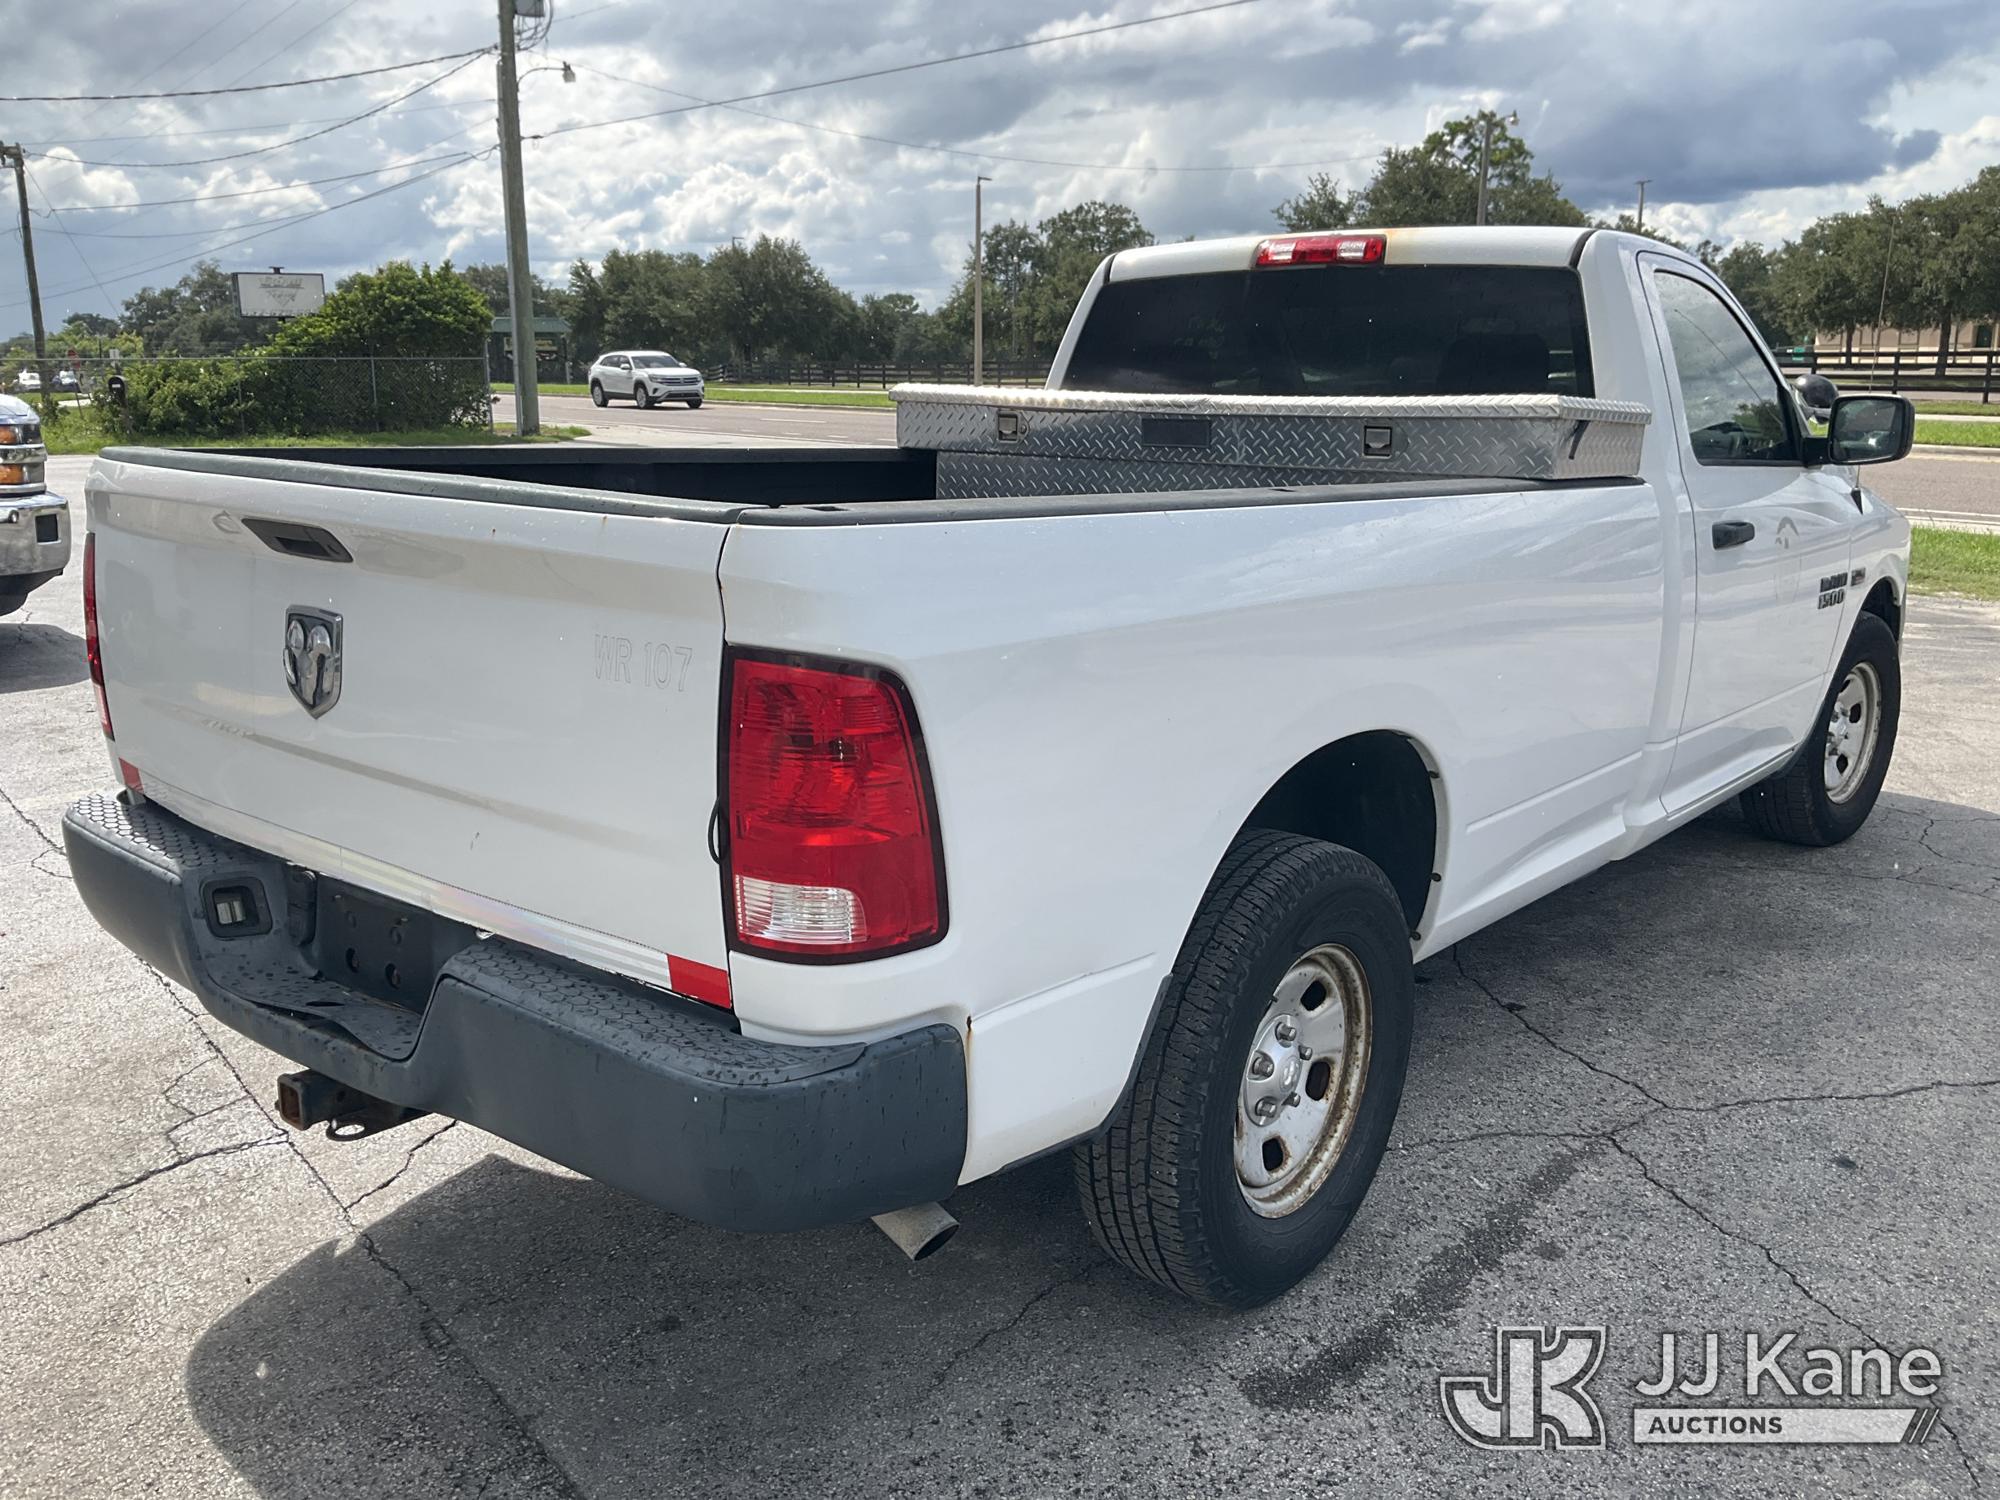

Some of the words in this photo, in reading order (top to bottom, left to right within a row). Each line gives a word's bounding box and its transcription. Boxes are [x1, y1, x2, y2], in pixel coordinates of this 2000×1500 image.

[1817, 588, 1845, 610] 1500
[594, 633, 632, 684] WR
[644, 641, 693, 692] 107
